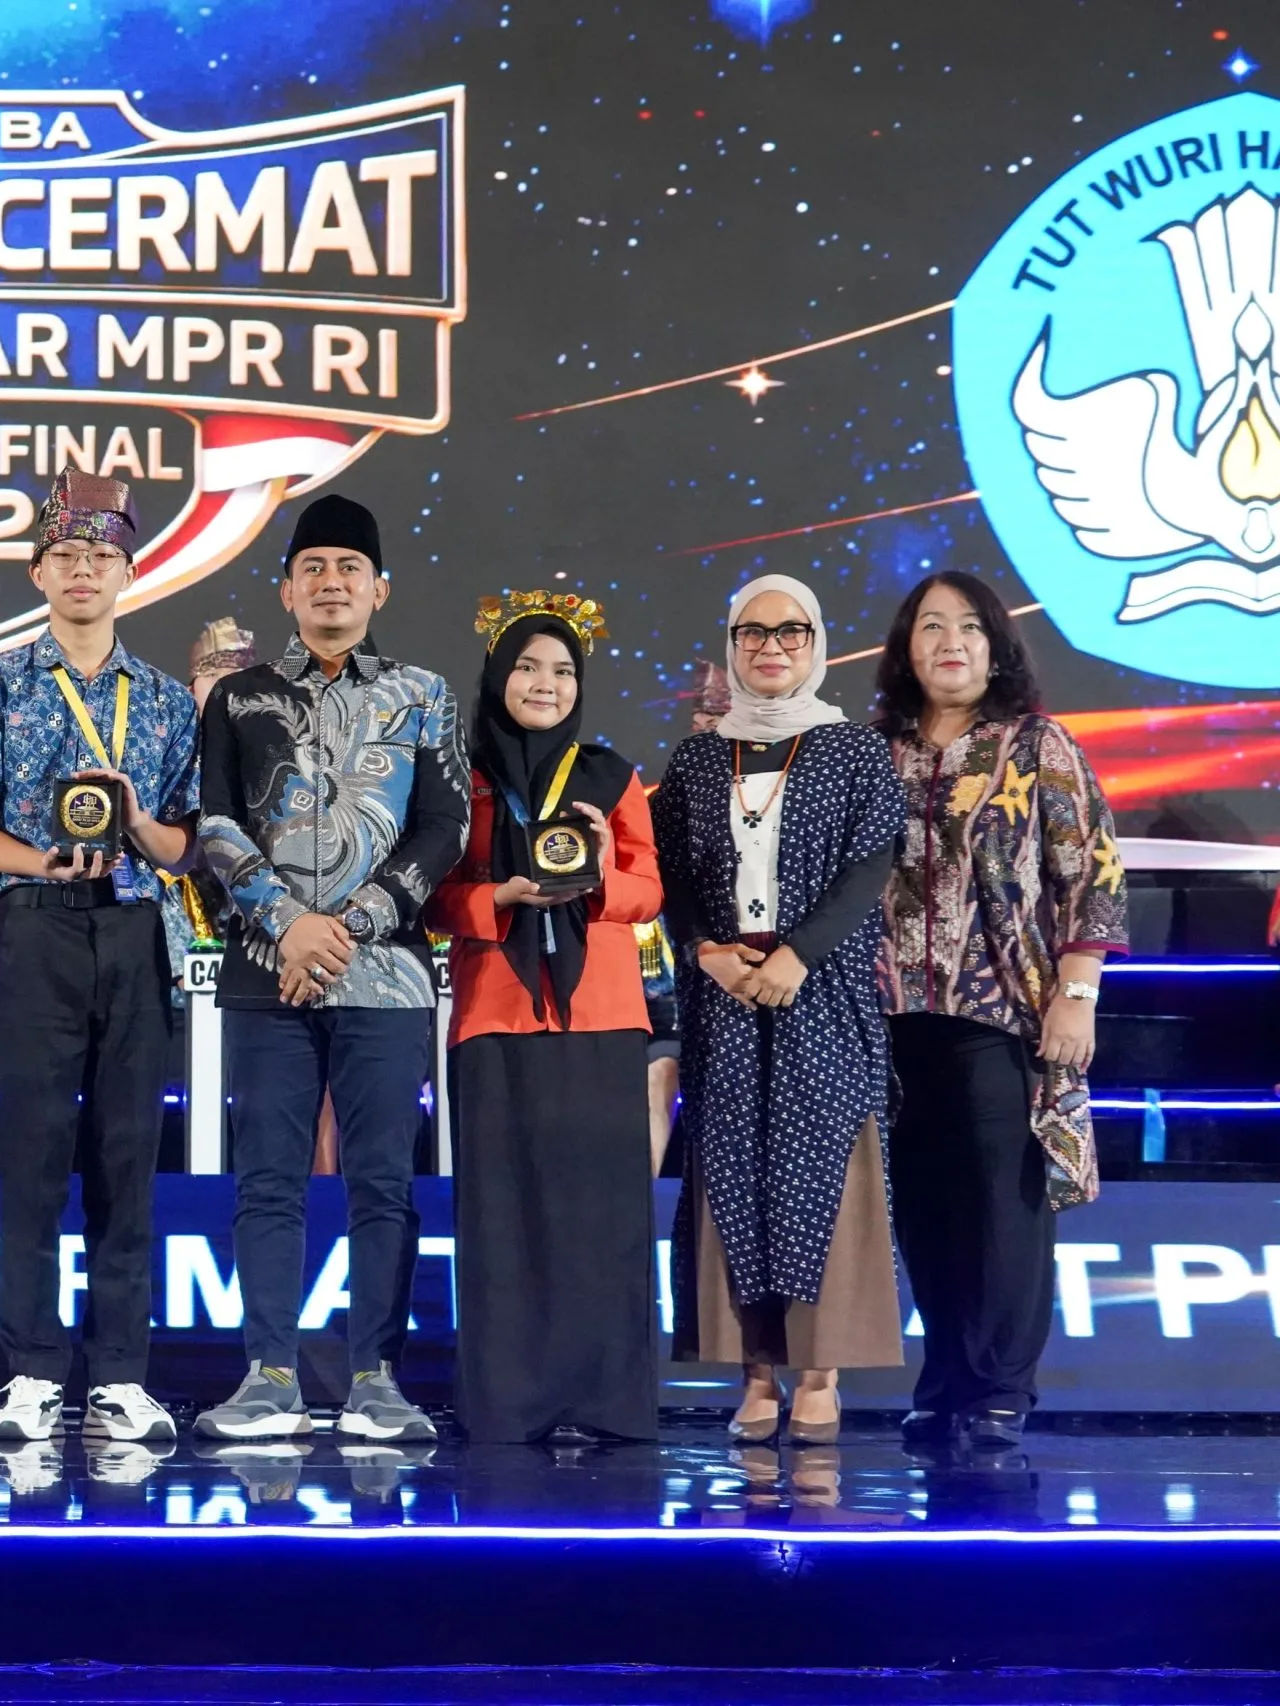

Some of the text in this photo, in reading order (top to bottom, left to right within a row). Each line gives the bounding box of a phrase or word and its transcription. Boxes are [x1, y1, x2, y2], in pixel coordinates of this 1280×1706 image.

[1012, 131, 1280, 291] TUT WURI H
[98, 315, 282, 387] MPR
[313, 324, 397, 399] RI
[190, 960, 220, 986] C4
